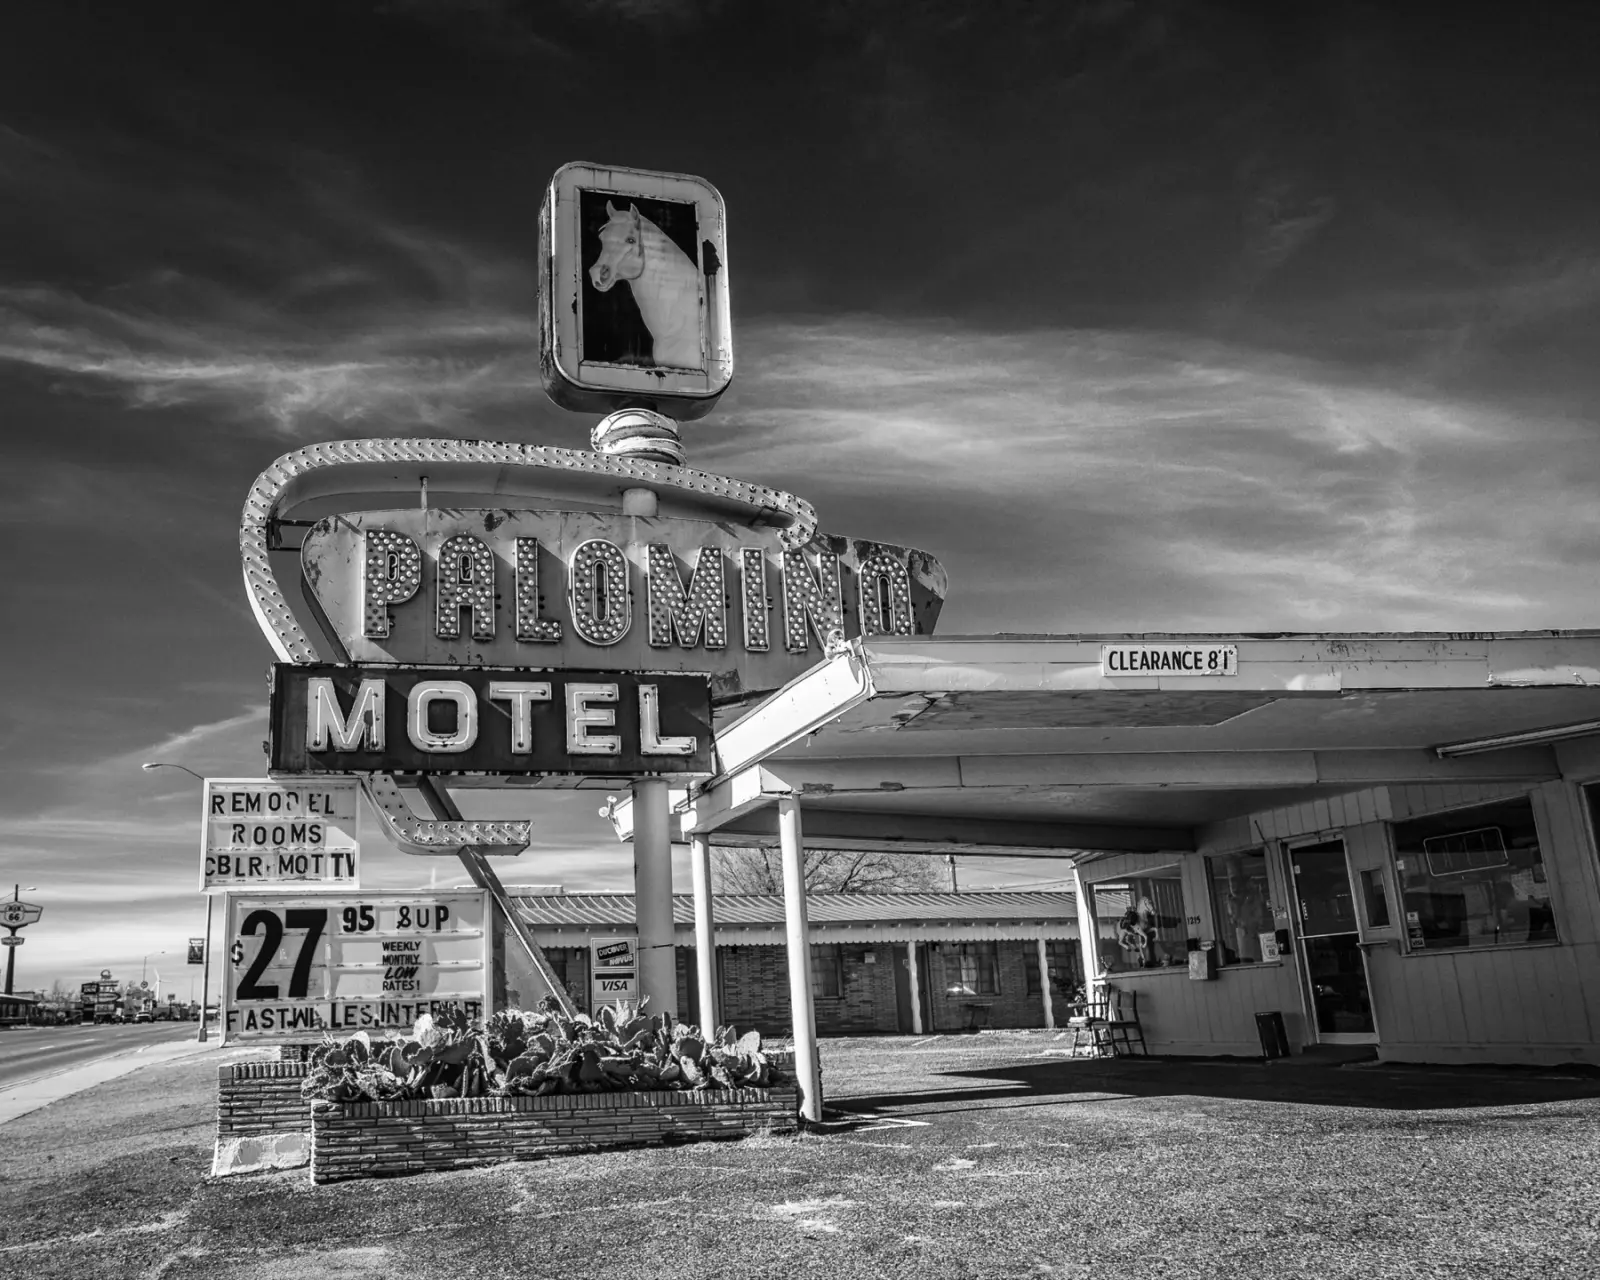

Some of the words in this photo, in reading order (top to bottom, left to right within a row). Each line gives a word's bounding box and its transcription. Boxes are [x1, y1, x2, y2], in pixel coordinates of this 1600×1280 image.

[361, 529, 914, 651] PALOMINO
[1108, 650, 1203, 671] CLEARANCE
[306, 677, 698, 756] MOTEL
[232, 823, 322, 846] ROOMS
[342, 904, 375, 933] 95
[381, 941, 421, 952] WEEKLY
[382, 954, 421, 966] MONTHLY
[384, 966, 419, 980] LOW
[382, 980, 421, 991] RATES!
[602, 980, 628, 991] VISA
